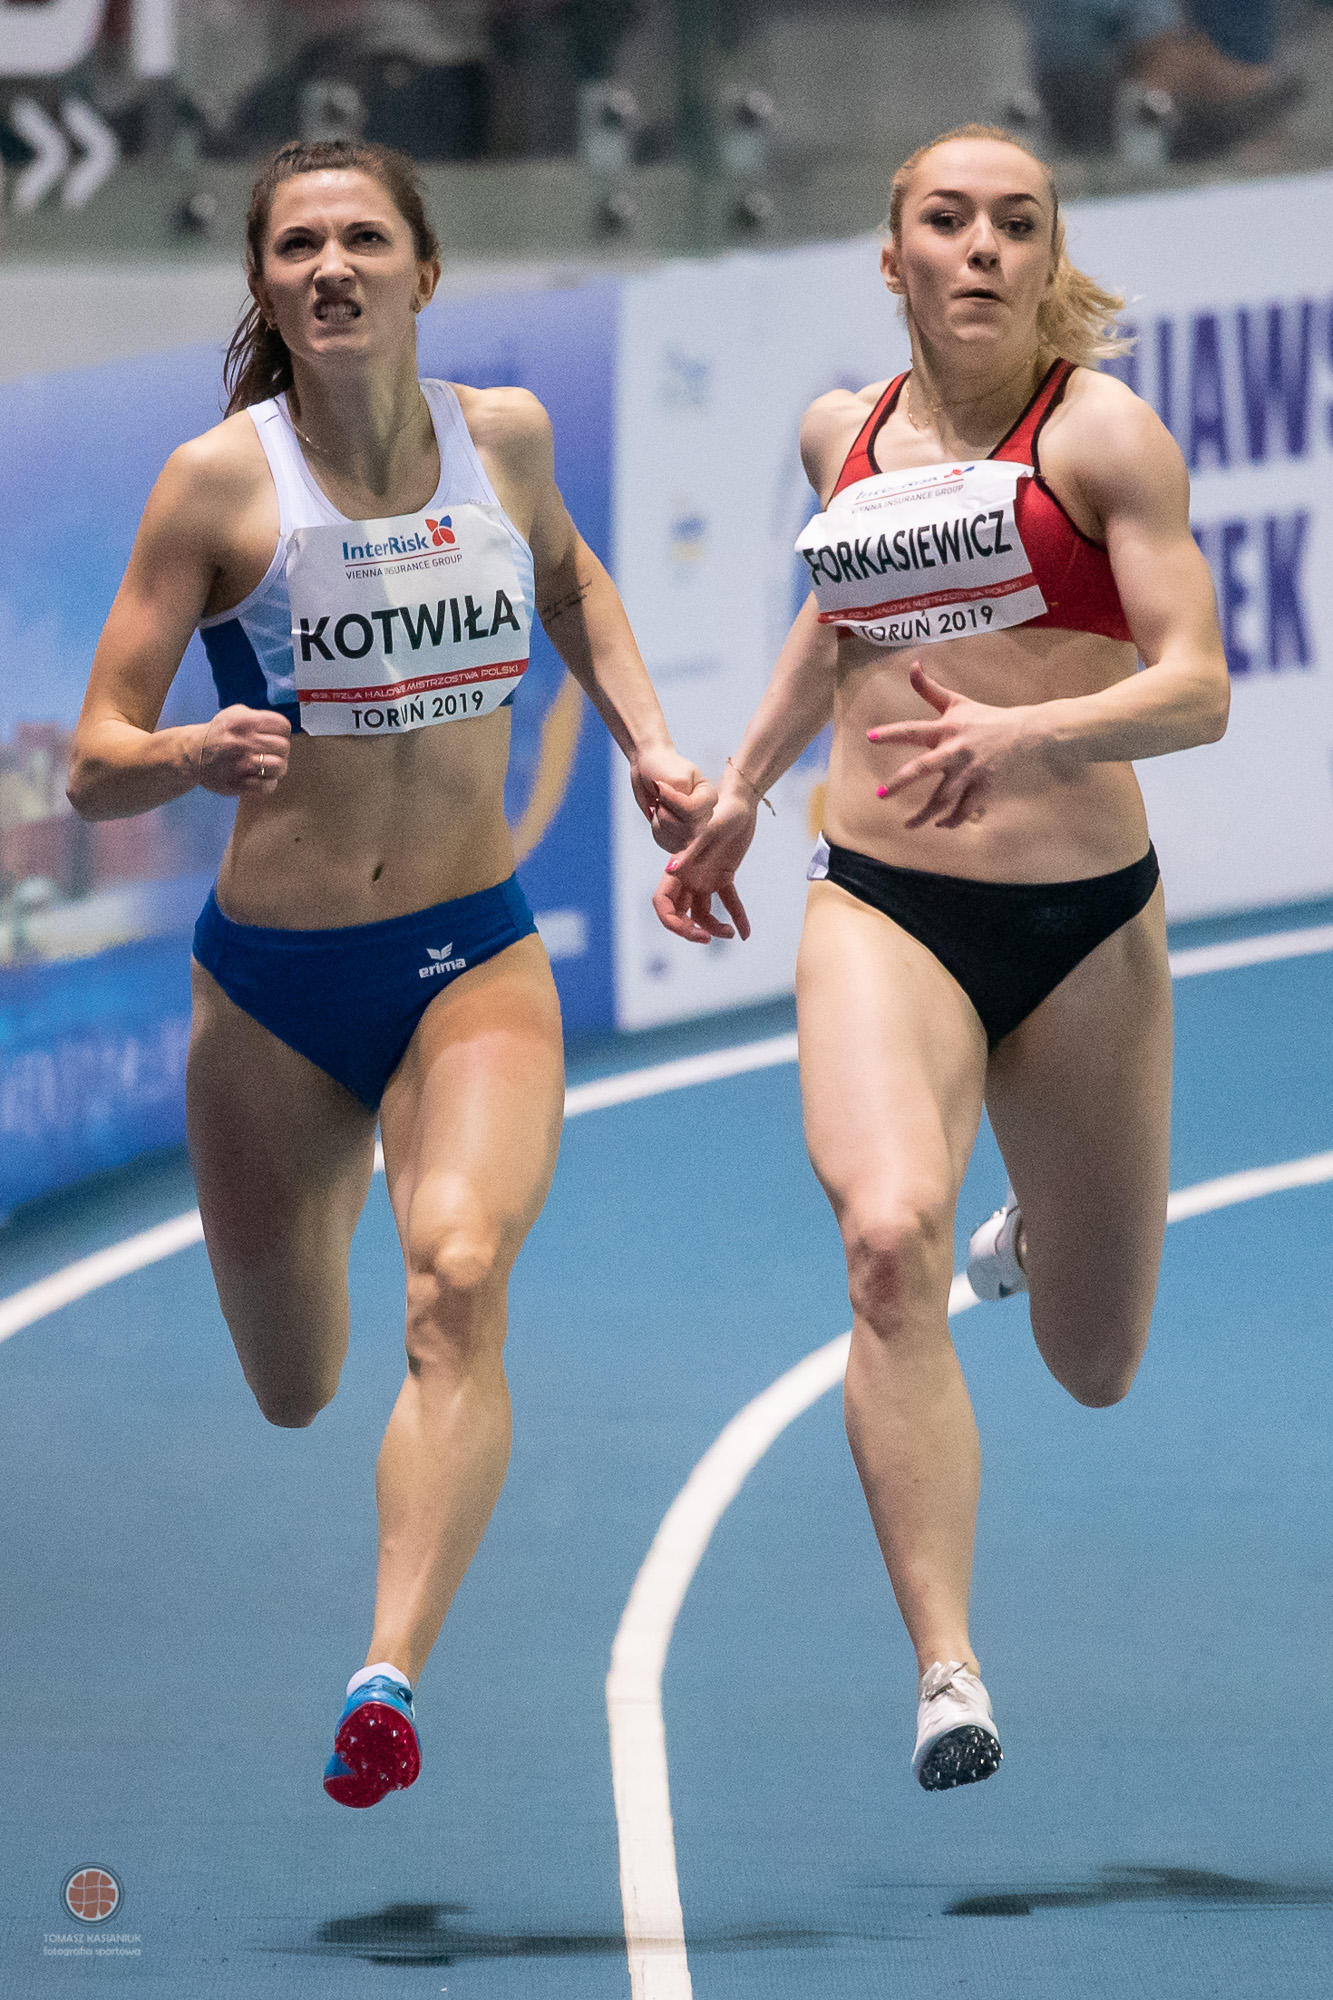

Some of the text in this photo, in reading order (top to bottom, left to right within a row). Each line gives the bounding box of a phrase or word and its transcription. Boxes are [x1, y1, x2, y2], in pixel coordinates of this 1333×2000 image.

[884, 491, 932, 507] INSURANCE
[934, 484, 964, 496] GROUP
[342, 533, 430, 561] InterRisk
[802, 509, 1013, 586] FORKASIEWICZ
[345, 554, 463, 580] VIENNA INSURANCE GROUP
[299, 589, 521, 662] KOTWIŁA
[859, 605, 994, 643] TORUŃ 2019
[332, 691, 363, 700] PZLA
[406, 671, 479, 691] MISTRZOSTWA
[480, 664, 519, 677] POLSKI
[351, 689, 485, 729] TORUŃ 2019
[418, 958, 467, 979] erima
